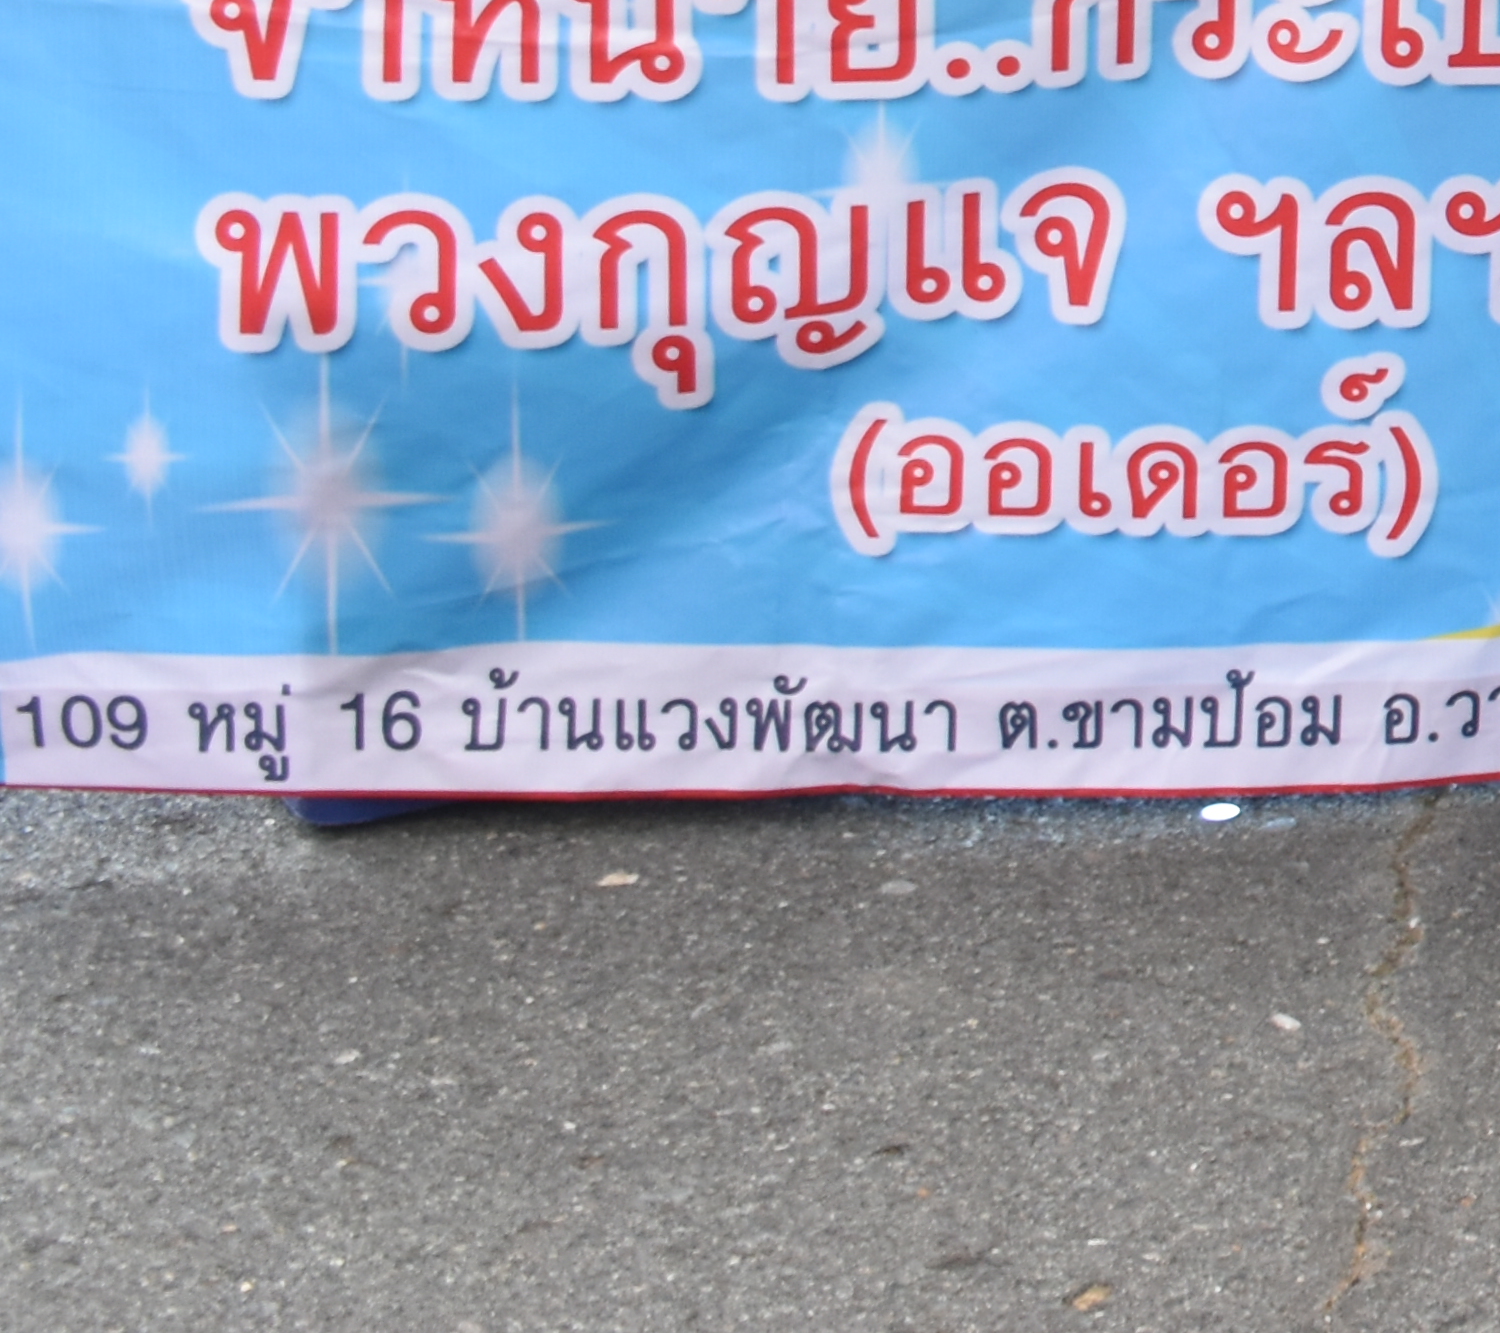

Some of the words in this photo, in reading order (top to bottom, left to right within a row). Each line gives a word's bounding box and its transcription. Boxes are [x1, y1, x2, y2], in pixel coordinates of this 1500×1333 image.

[215, 181, 1112, 394] พวงกุญแจ
[848, 368, 1423, 539] (ออเดอร์)
[16, 695, 148, 750] 109
[188, 684, 291, 781] หมู่
[340, 690, 422, 752] 16
[461, 667, 957, 756] บ้านแวงพัฒนา
[999, 669, 1343, 751] ต.ขามป้อม
